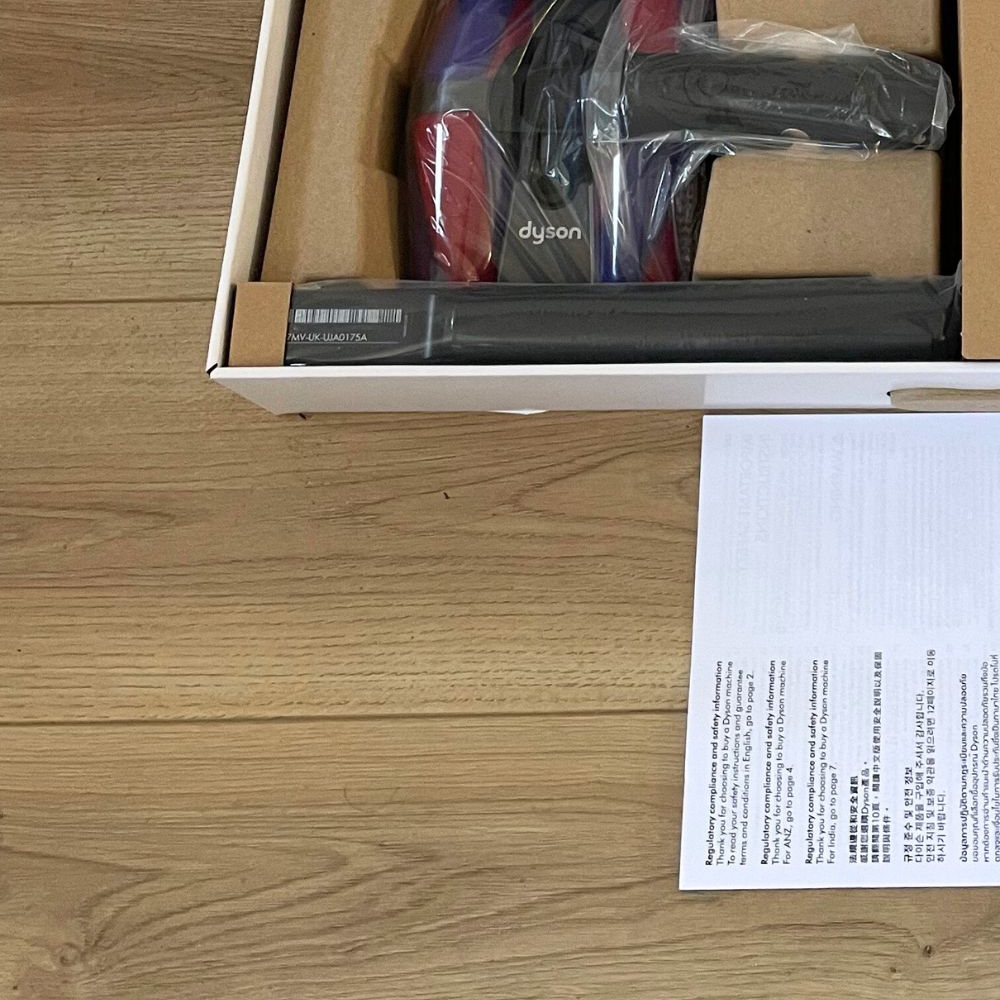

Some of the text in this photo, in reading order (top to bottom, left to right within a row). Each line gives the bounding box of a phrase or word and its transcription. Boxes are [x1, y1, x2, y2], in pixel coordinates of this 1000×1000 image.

[518, 218, 582, 246] dyson
[724, 661, 734, 697] machine
[734, 669, 744, 713] guarantee
[777, 660, 787, 697] machine
[820, 660, 829, 696] machine
[722, 698, 732, 726] Dyson
[733, 714, 742, 731] and
[776, 698, 786, 725] Dyson
[819, 697, 830, 724] Dyson
[721, 734, 732, 751] buy
[774, 734, 786, 750] buy
[818, 733, 829, 750] buy
[970, 724, 980, 752] Dyson
[705, 660, 723, 866] Regulatory compliance and safety information
[721, 752, 729, 762] to
[730, 733, 741, 781] instructions
[760, 660, 776, 865] Regulatory compliance and safety information
[775, 752, 783, 761] to
[804, 659, 819, 864] Regulatory compliance and safety information
[819, 751, 827, 760] to
[719, 763, 730, 803] choosing
[739, 681, 756, 866] terms and conditions in English, go to page
[773, 762, 785, 802] choosing
[817, 762, 828, 802] choosing
[729, 783, 741, 808] safety
[717, 805, 727, 818] for
[772, 804, 782, 817] for
[782, 775, 795, 865] For ANZ, go to page
[816, 803, 826, 817] for
[826, 772, 839, 864] For India, go to page
[720, 819, 728, 836] you
[716, 838, 725, 866] Thank
[728, 832, 737, 853] read
[771, 837, 780, 865] Thank
[815, 836, 825, 864] Thank
[727, 854, 736, 866] To
